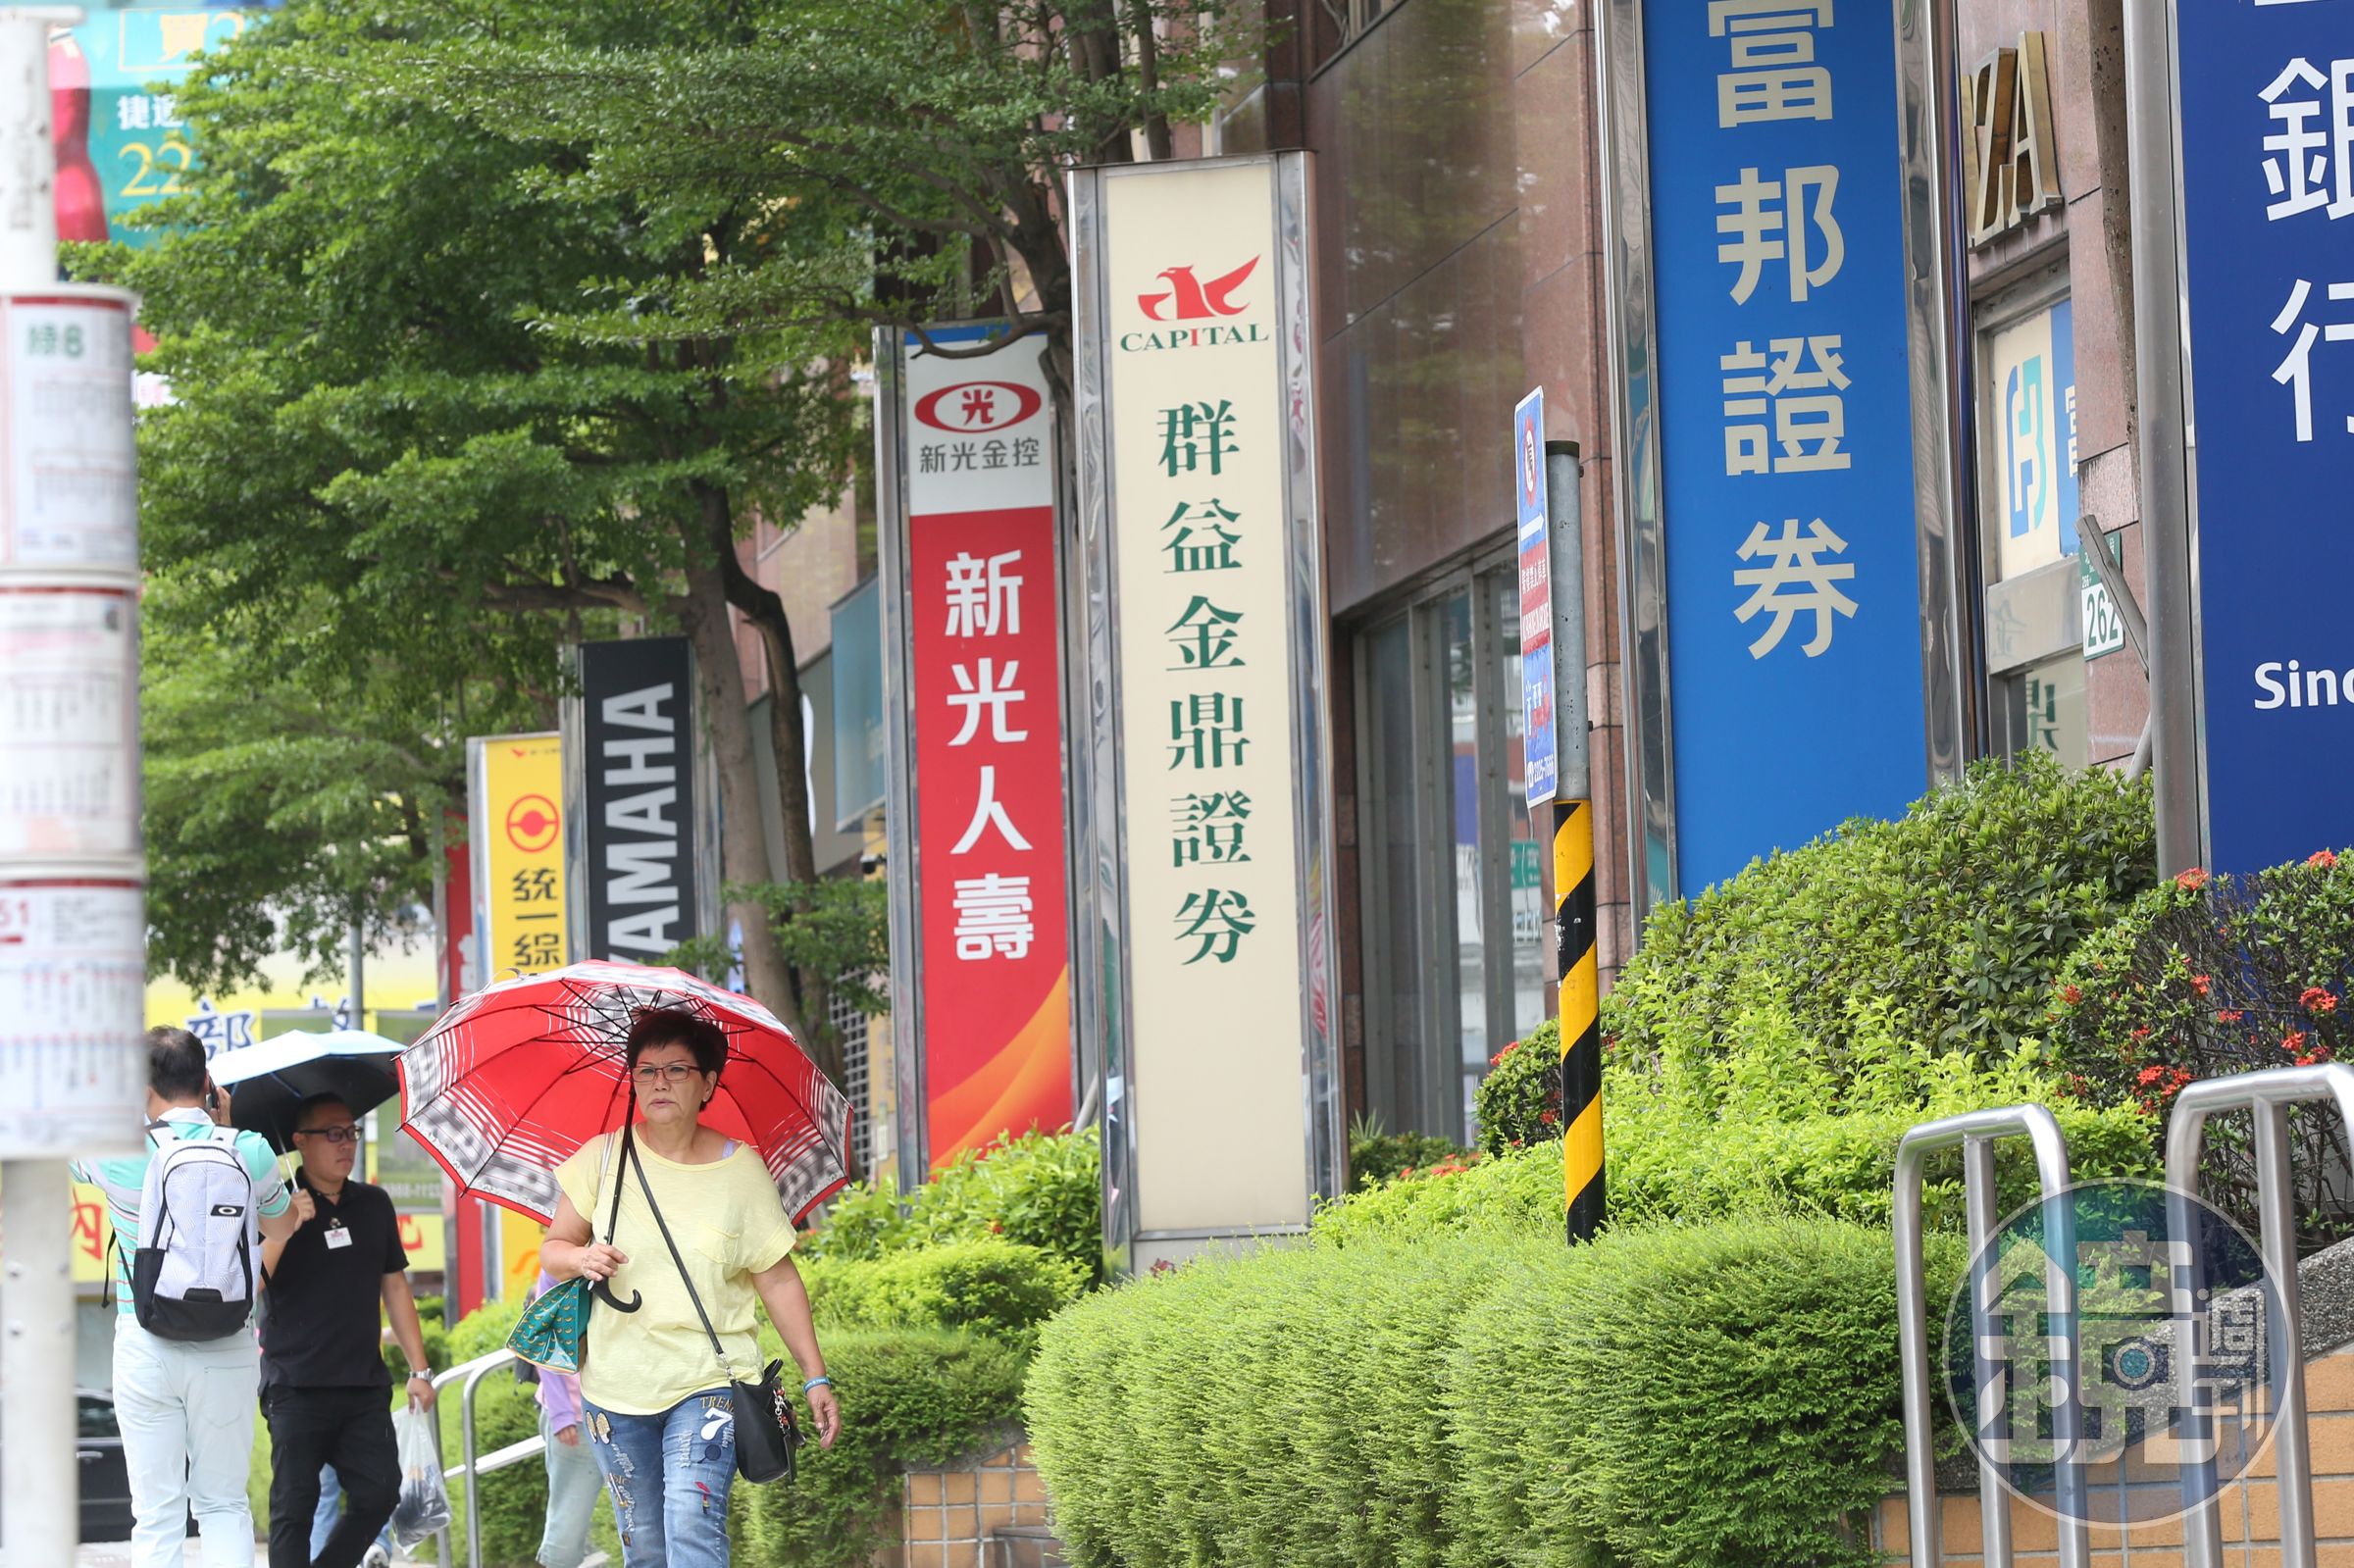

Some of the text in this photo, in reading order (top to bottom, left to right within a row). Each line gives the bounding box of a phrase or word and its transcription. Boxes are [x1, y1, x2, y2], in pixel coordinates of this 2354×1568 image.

[1962, 30, 2064, 253] ZA
[2255, 0, 2354, 441] 銀行
[920, 437, 1041, 474] 新光金控
[1120, 324, 1269, 352] CAPITAL
[1708, 0, 1859, 660] 富邦證券
[602, 682, 681, 966] AMAHA
[945, 549, 1035, 961] 新光人壽
[1155, 399, 1255, 966] 群益金鼎證券
[512, 868, 560, 977] 統一綜
